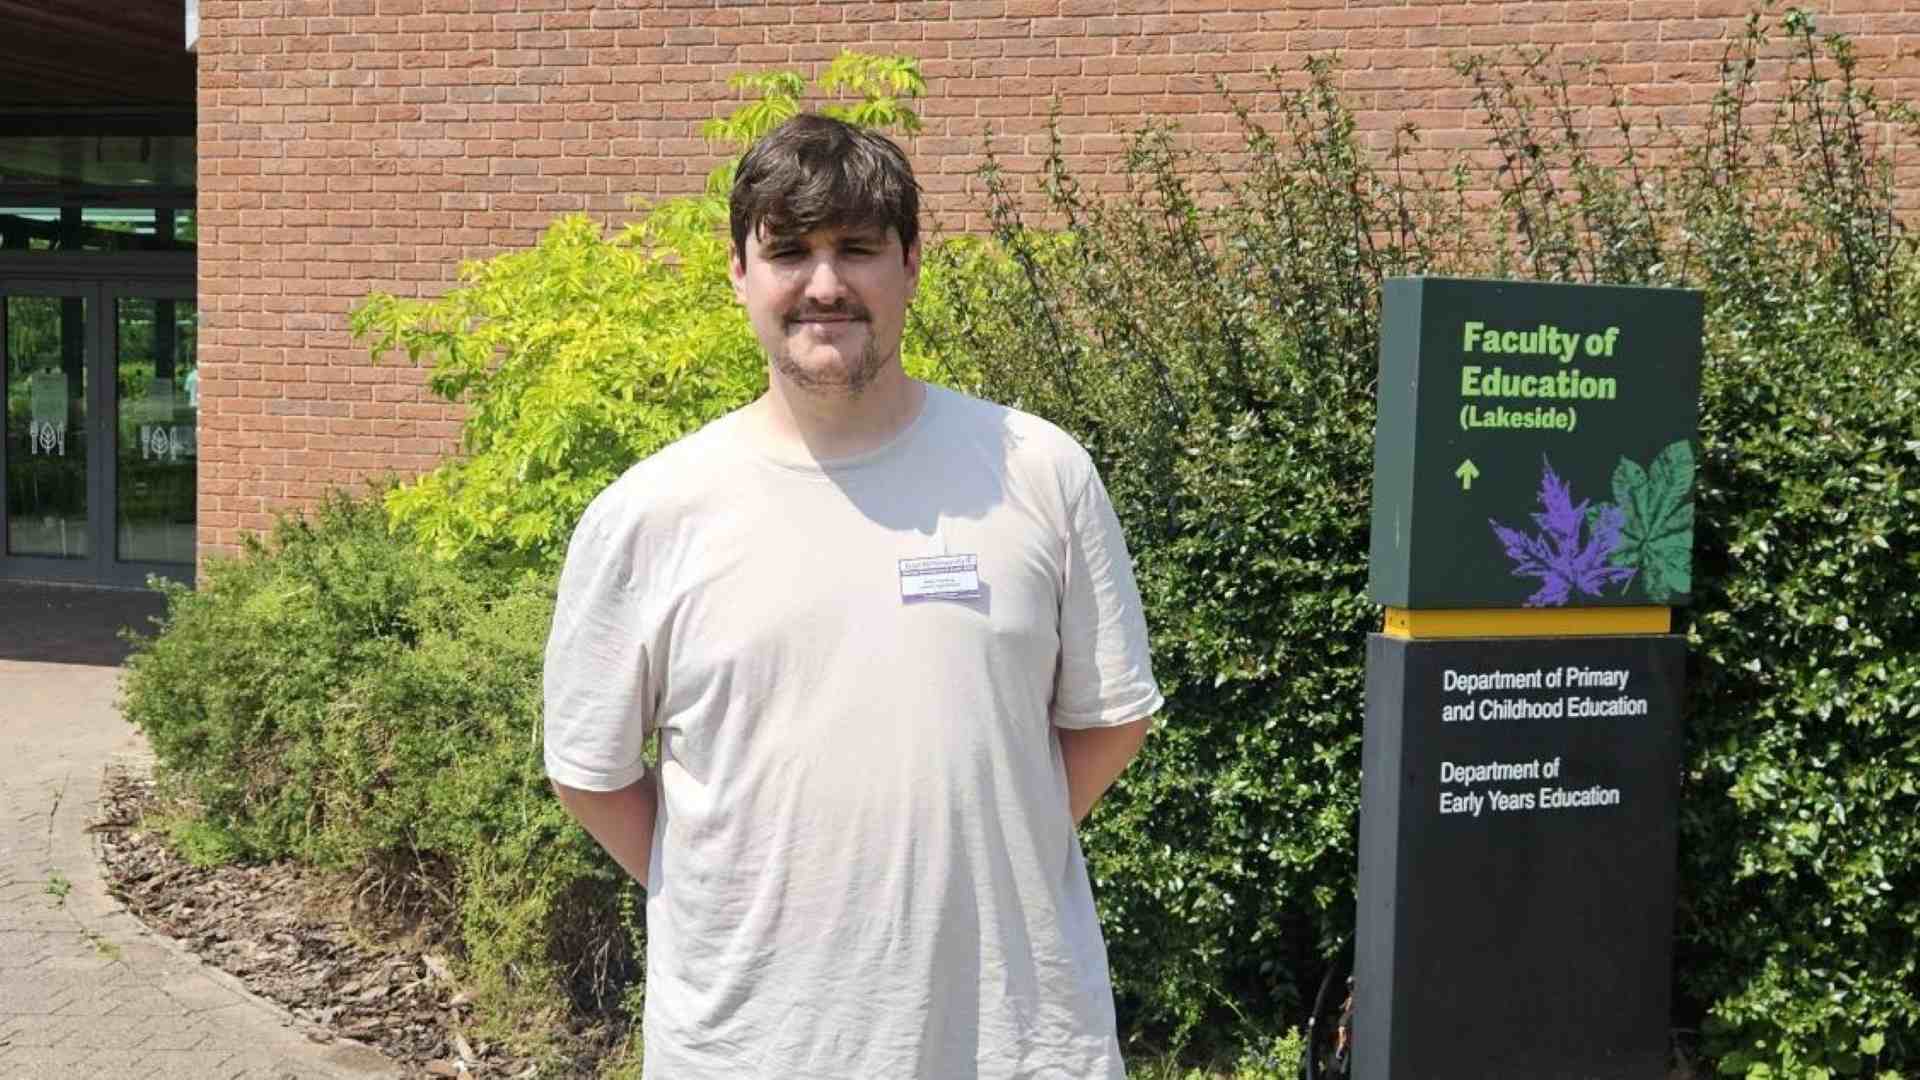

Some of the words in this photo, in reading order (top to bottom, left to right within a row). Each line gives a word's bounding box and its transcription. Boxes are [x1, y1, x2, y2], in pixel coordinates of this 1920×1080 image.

[1463, 321, 1580, 363] Faculty
[1585, 327, 1619, 356] of
[1461, 366, 1617, 400] Education
[1460, 405, 1577, 432] (Lakeside)
[1443, 669, 1542, 695] Department
[1545, 667, 1562, 689] of
[1566, 667, 1630, 691] Primary
[1442, 700, 1474, 722] and
[1479, 698, 1563, 720] Childhood
[1567, 695, 1648, 717] Education
[1440, 759, 1539, 786] Department
[1543, 757, 1561, 778] of
[1439, 791, 1484, 817] Early
[1488, 790, 1535, 811] Years
[1539, 785, 1620, 809] Education
